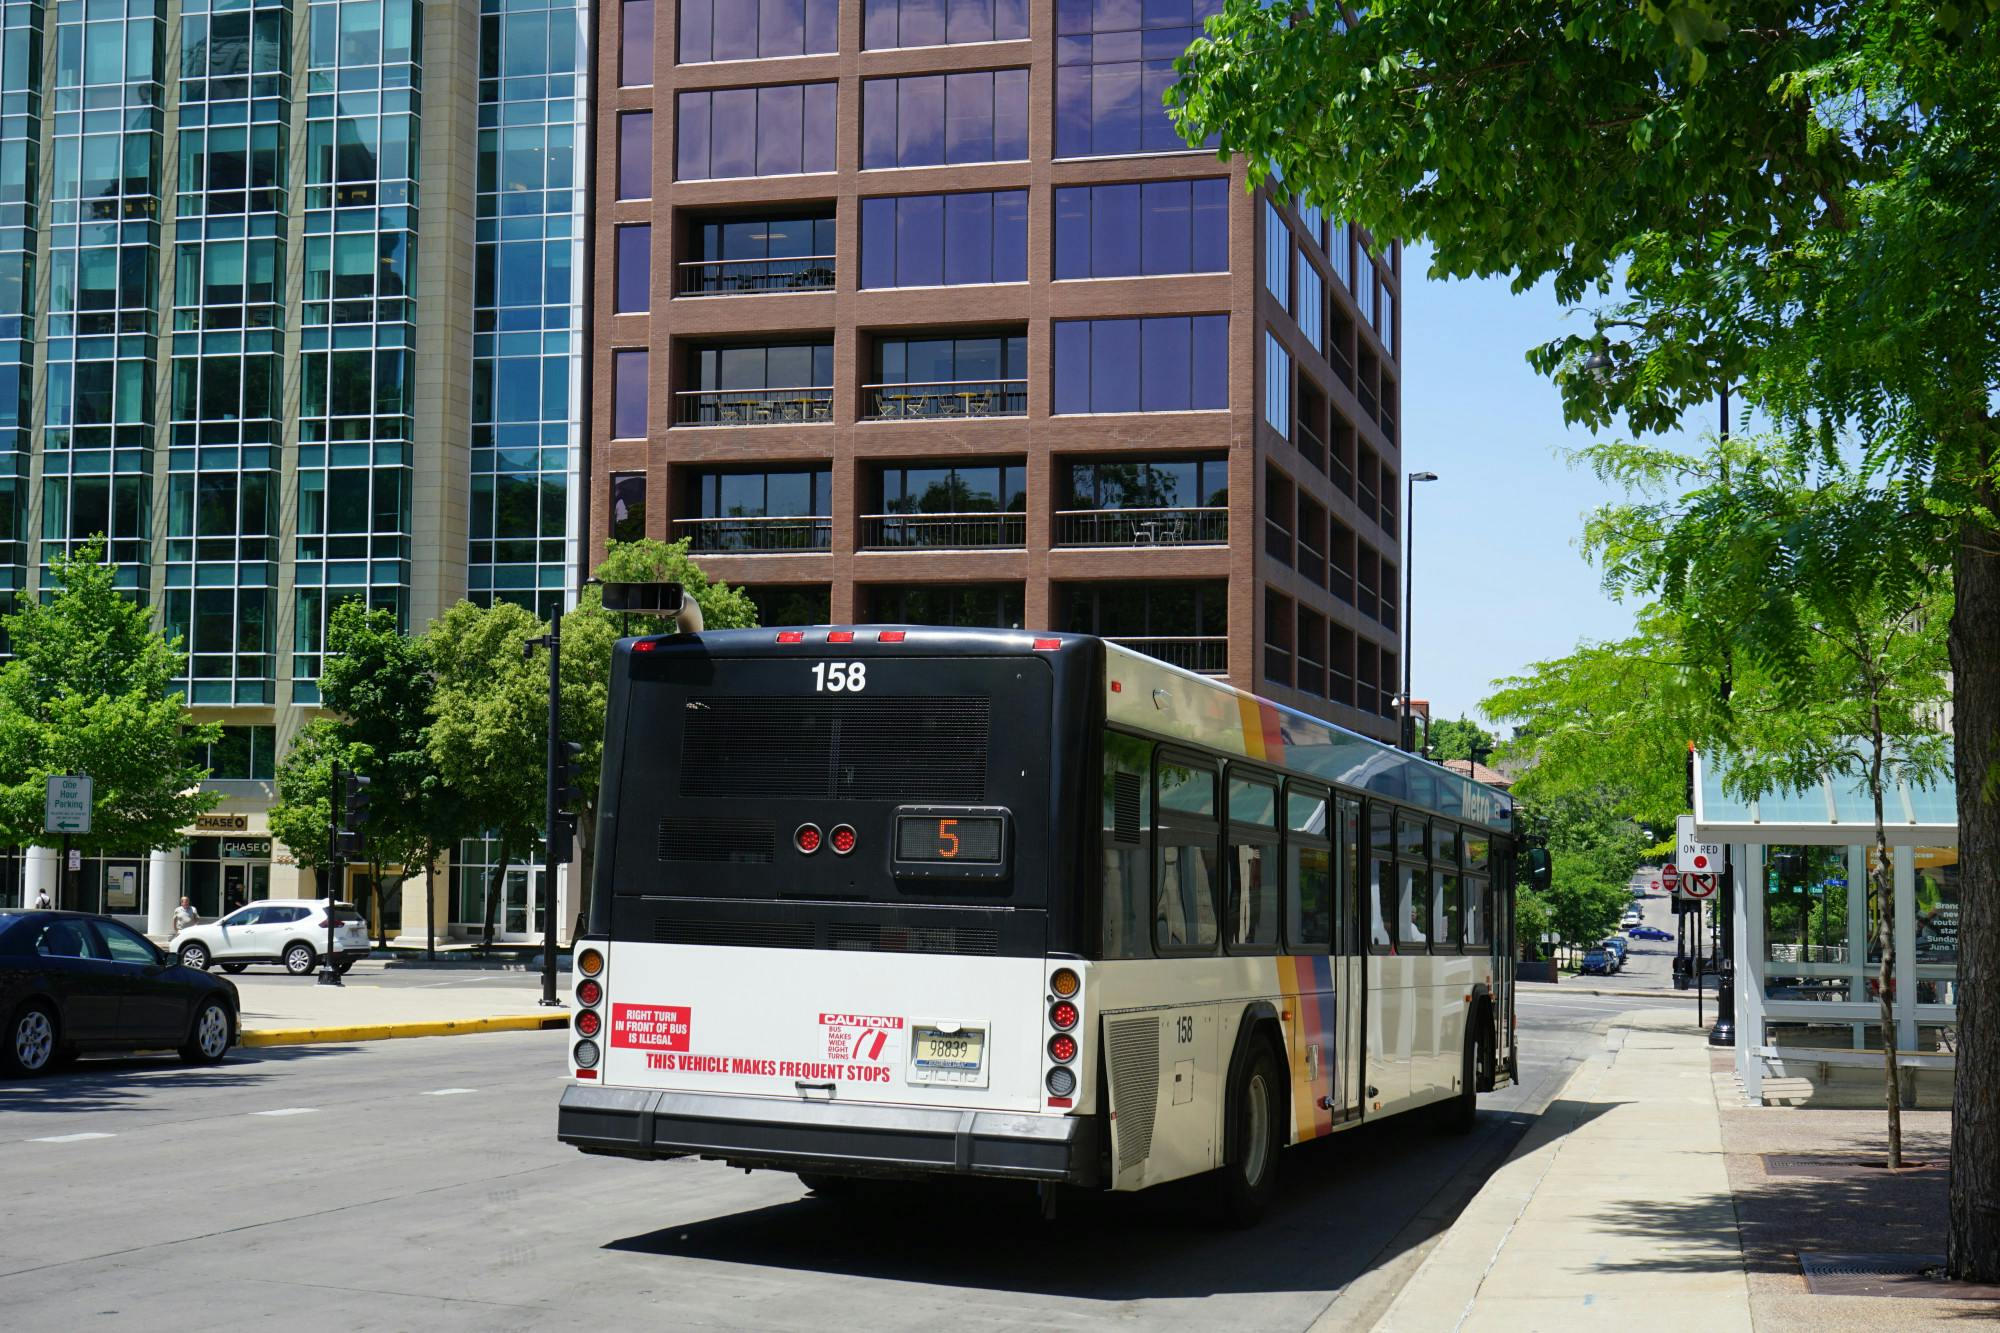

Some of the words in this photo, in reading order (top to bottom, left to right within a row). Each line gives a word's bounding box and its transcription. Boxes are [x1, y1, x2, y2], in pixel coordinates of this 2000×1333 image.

[812, 662, 866, 692] 158
[60, 790, 78, 798] Hour
[54, 800, 82, 810] Parking
[1462, 780, 1490, 824] Metro
[198, 818, 232, 827] CHASE
[940, 819, 958, 857] 5
[225, 842, 260, 852] CHASE
[1684, 844, 1696, 854] ON
[1700, 845, 1718, 854] RED
[626, 1010, 652, 1021] RIGHT
[654, 1011, 676, 1022] TURN
[824, 1014, 898, 1028] CAUTION!
[616, 1020, 624, 1030] IN
[626, 1022, 654, 1032] FRONT
[656, 1023, 668, 1033] OF
[670, 1024, 687, 1034] BUS
[1176, 1016, 1192, 1044] 158
[628, 1032, 638, 1043] IS
[640, 1034, 672, 1045] ILLEGAL
[930, 1040, 968, 1058] 98839
[646, 1054, 675, 1070] THIS
[678, 1056, 729, 1073] VEHICLE
[732, 1058, 776, 1076] MAKES
[780, 1062, 844, 1080] FREQUENT
[847, 1065, 890, 1082] STOPS
